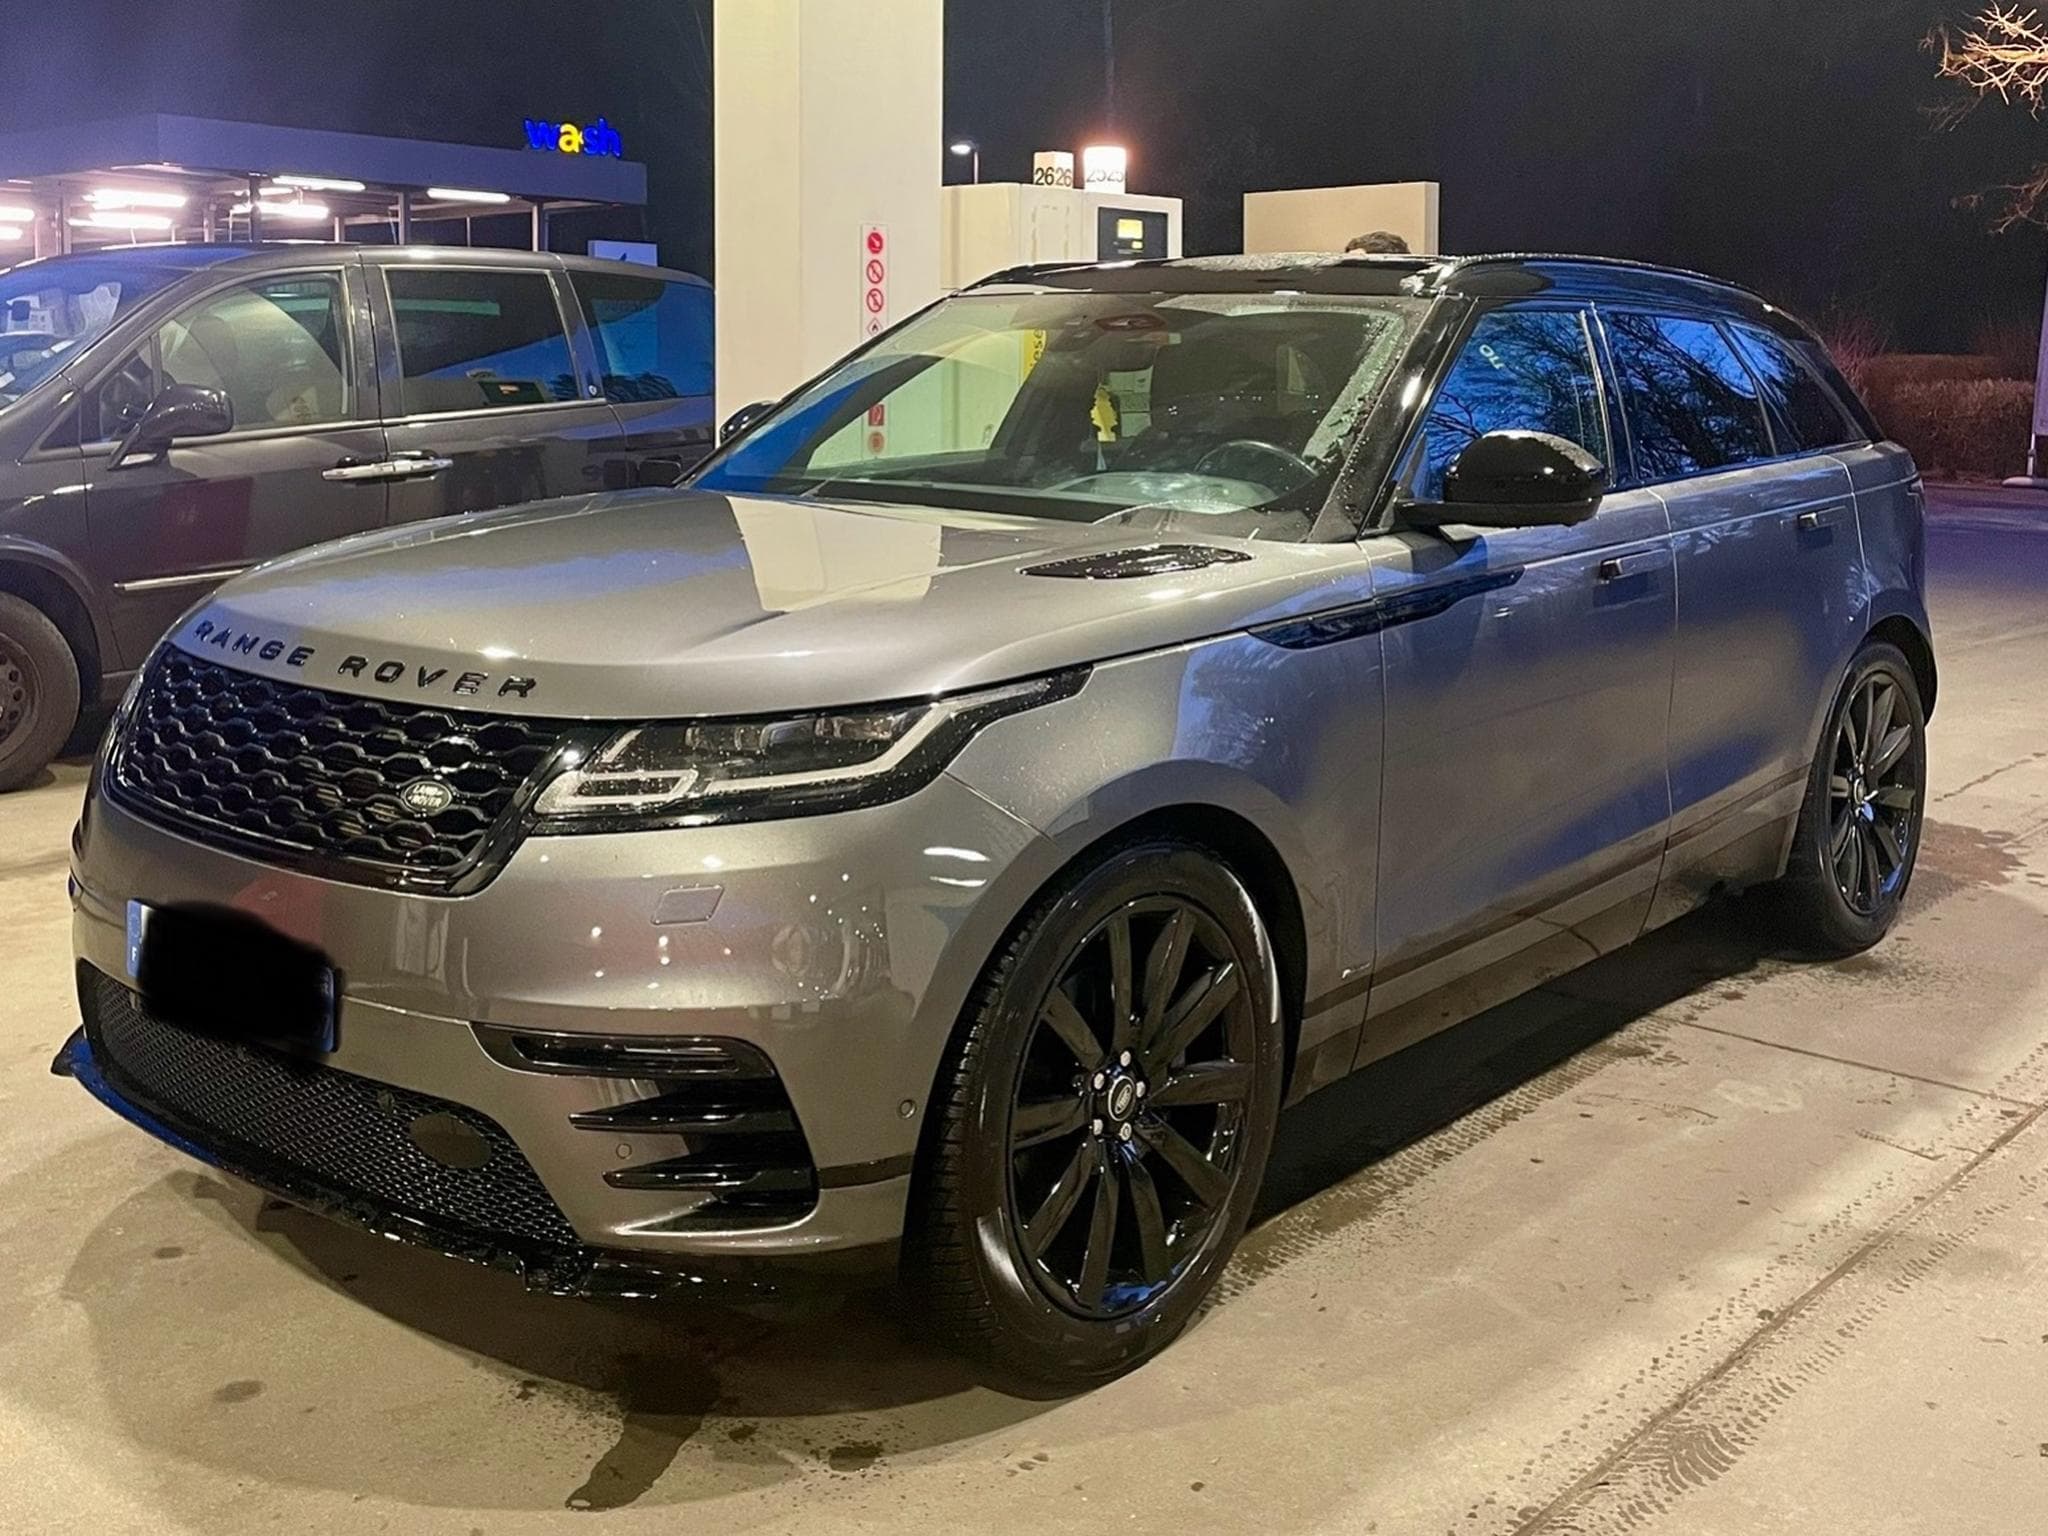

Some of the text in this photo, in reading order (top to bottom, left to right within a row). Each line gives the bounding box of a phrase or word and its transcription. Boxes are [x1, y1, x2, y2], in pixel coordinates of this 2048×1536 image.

[524, 117, 622, 158] wash
[1034, 167, 1055, 186] 26
[1055, 167, 1073, 187] 26
[193, 620, 537, 698] RANGE ROVER
